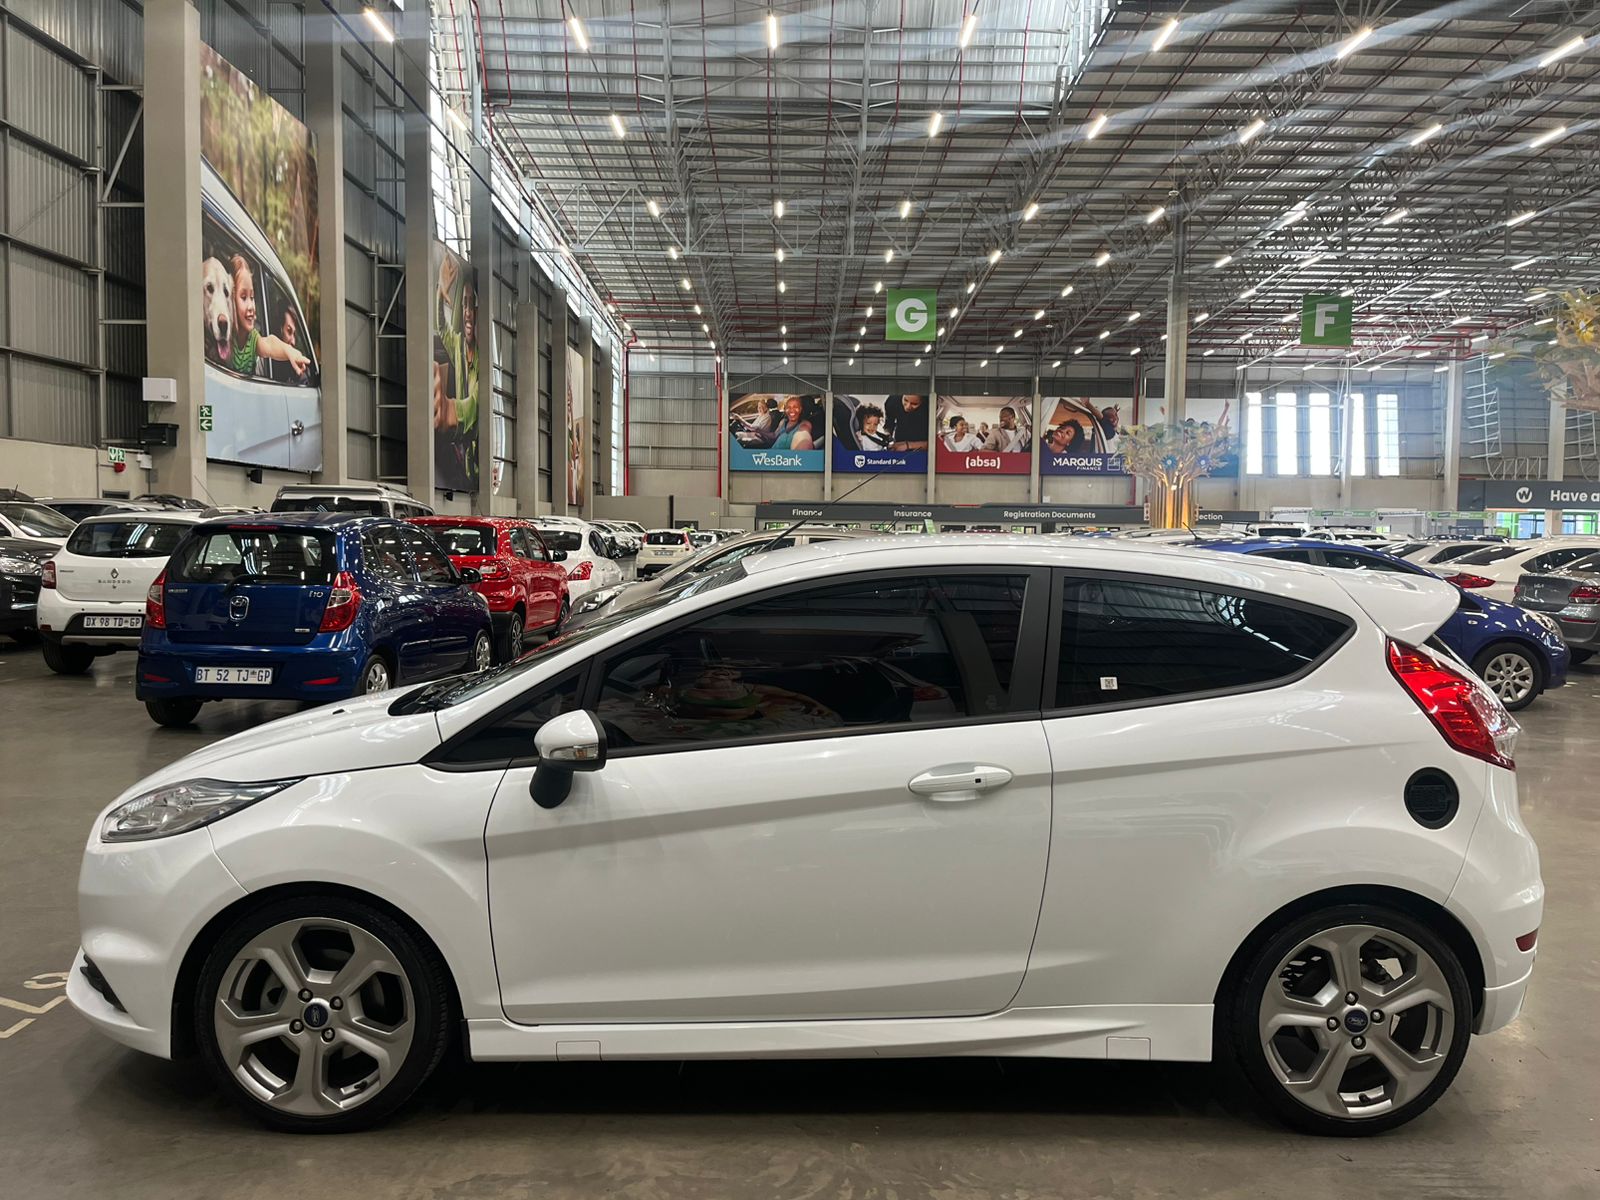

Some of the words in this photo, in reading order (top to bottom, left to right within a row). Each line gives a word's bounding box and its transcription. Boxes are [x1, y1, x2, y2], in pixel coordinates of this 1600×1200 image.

[895, 297, 929, 333] G
[1314, 303, 1340, 337] F
[752, 453, 803, 467] WesBank
[867, 458, 892, 466] Standard
[965, 455, 1001, 470] (absa)
[1053, 457, 1103, 467] MARQUIS
[1550, 489, 1588, 502] Have
[893, 509, 932, 518] Insurance
[1003, 510, 1050, 521] Registration
[1051, 511, 1096, 520] Documents
[1198, 512, 1224, 521] ection
[86, 617, 97, 627] DX
[99, 617, 110, 627] 98
[113, 617, 123, 627] TD
[129, 617, 141, 627] GP
[196, 668, 211, 681] BT
[216, 669, 229, 682] 52
[236, 670, 250, 682] TJ
[257, 670, 271, 683] GP
